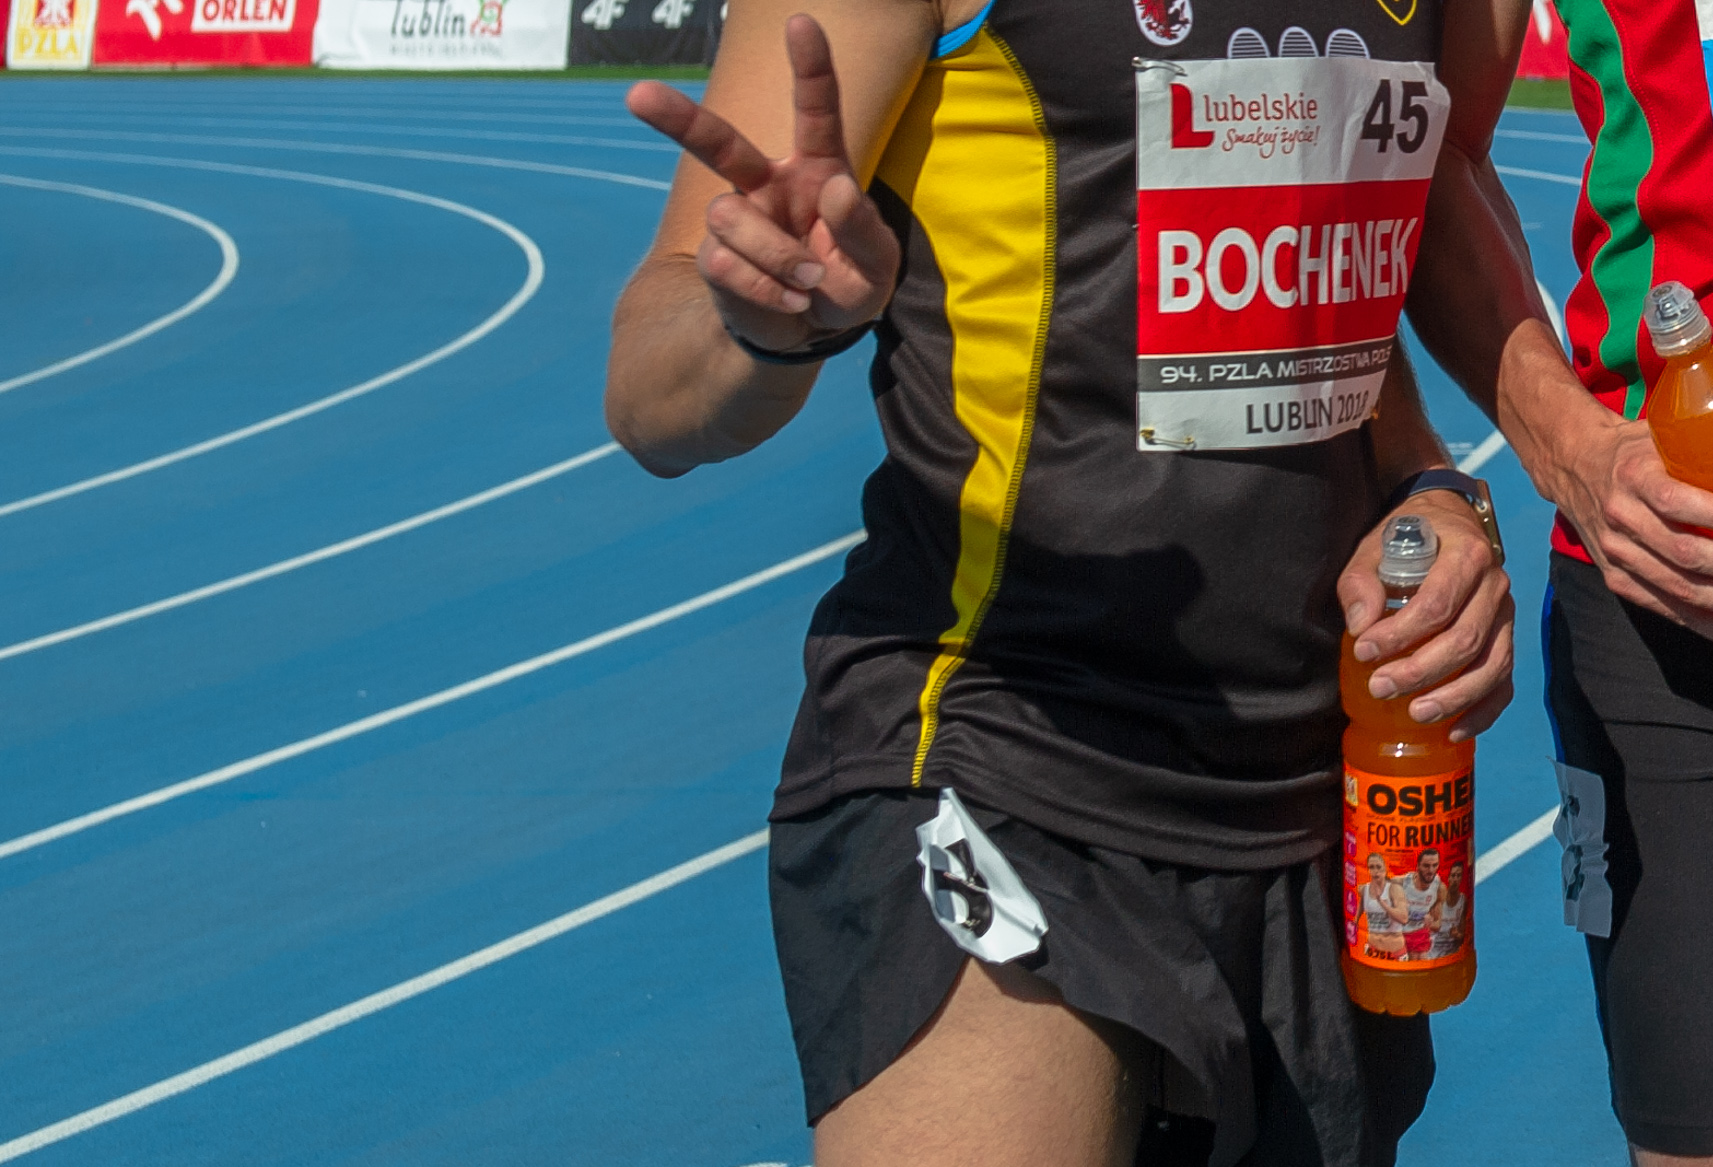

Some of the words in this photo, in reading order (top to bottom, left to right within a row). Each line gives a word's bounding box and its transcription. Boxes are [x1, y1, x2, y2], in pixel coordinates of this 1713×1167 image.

[18, 28, 78, 55] PZLA
[1360, 79, 1430, 154] 45
[1222, 127, 1278, 159] Smakuj
[1281, 125, 1320, 154] życie!
[1158, 217, 1418, 313] BOCHENEK
[1160, 366, 1202, 383] 94.
[1209, 363, 1273, 381] PZLA
[1246, 396, 1333, 434] LUBLIN
[1337, 390, 1369, 423] 2018
[1367, 774, 1469, 817] OSHE
[1367, 821, 1401, 847] FOR
